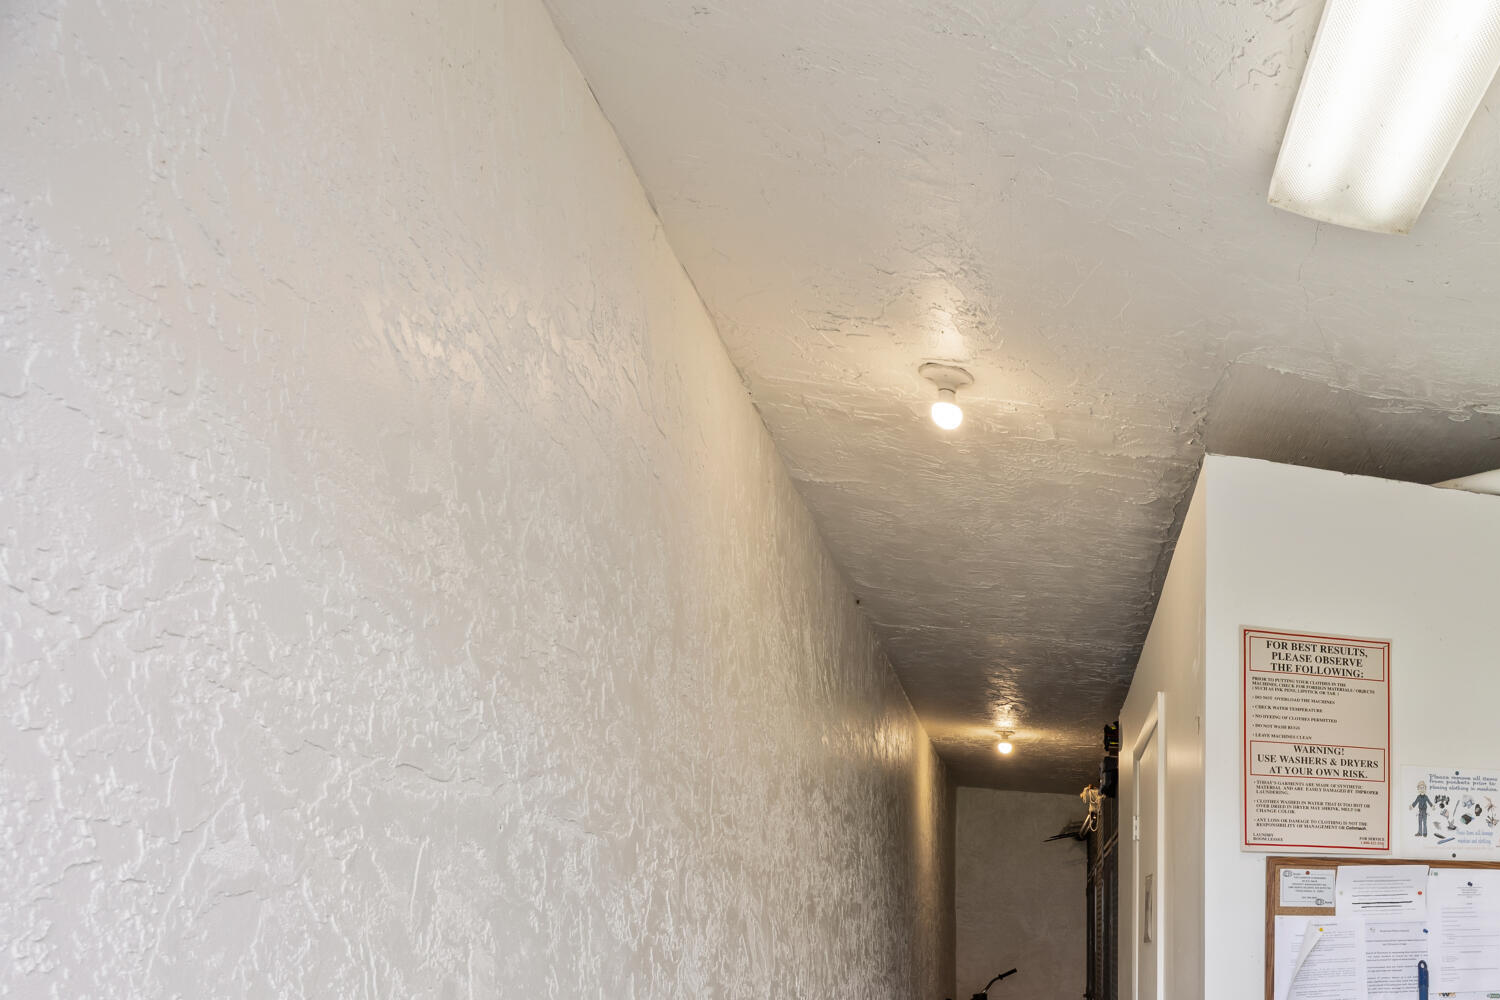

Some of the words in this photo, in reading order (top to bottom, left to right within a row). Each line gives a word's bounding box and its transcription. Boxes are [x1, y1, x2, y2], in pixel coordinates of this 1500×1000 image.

[1266, 640, 1288, 650] FOR
[1291, 642, 1317, 652] BEST
[1320, 644, 1368, 658] RESULTS,
[1272, 652, 1312, 662] PLEASE
[1315, 655, 1362, 668] OBSERVE
[1270, 662, 1292, 672] THE
[1295, 664, 1364, 678] FOLLOWING:
[1294, 745, 1344, 756] WARNING!
[1258, 754, 1276, 762] USE
[1280, 755, 1328, 765] WASHERS
[1330, 758, 1337, 766] &
[1340, 759, 1379, 768] DRYERS
[1270, 766, 1282, 774] AT
[1284, 767, 1313, 776] YOUR
[1316, 768, 1340, 777] OWN
[1342, 770, 1368, 779] RISK.
